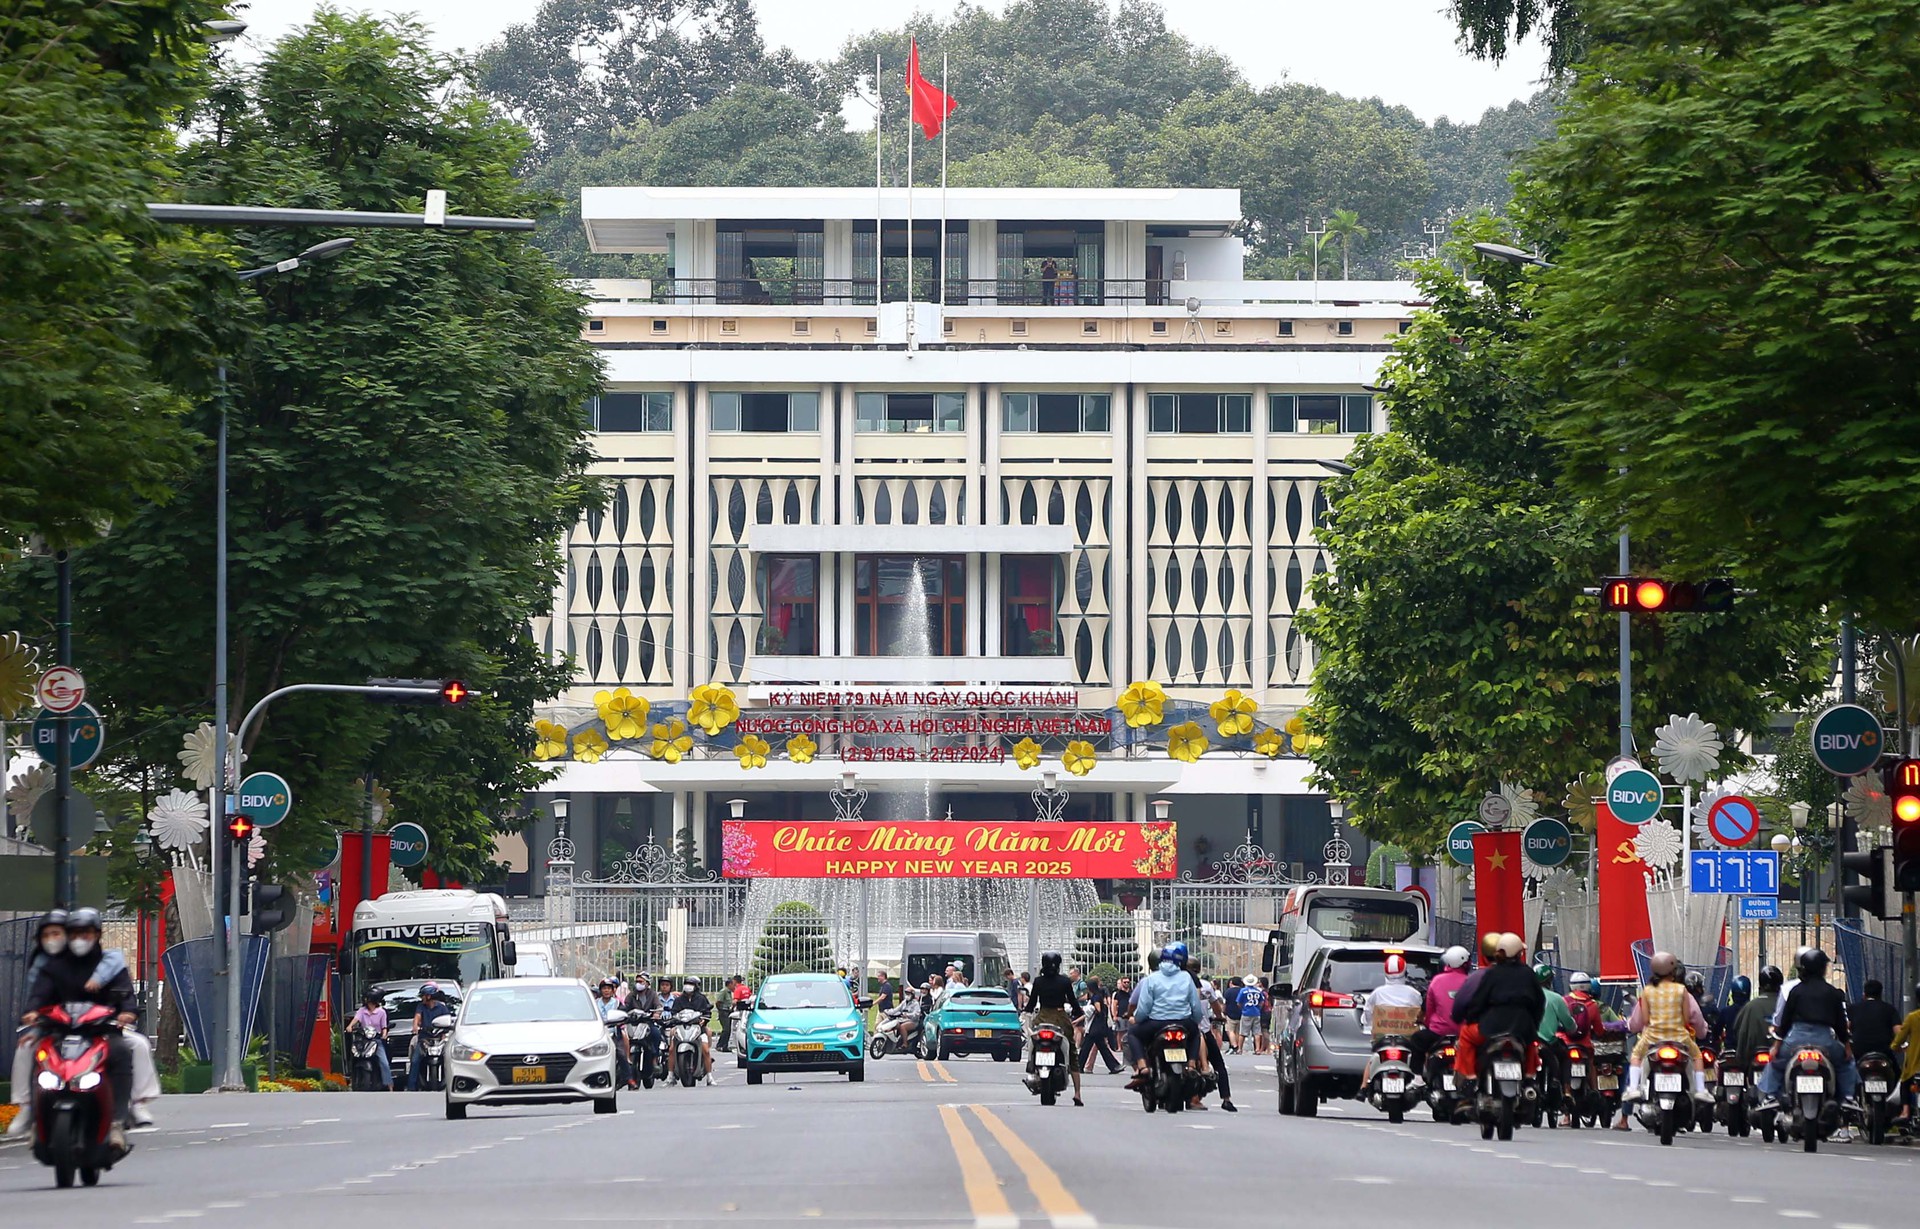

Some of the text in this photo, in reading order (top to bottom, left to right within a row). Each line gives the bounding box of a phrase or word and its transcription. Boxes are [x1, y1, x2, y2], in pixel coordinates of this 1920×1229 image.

[846, 691, 864, 706] 79
[869, 687, 908, 706] NĂM
[914, 687, 961, 706] NGÀY
[1020, 687, 1079, 706] KHÁNH
[843, 715, 879, 734] HÒA
[882, 715, 906, 734] XÃ
[981, 715, 1034, 733] NGHĨA
[1074, 718, 1112, 734] NAM
[39, 728, 81, 744] BIV
[1820, 734, 1862, 750] BIDV
[840, 746, 916, 765] (2/9/1945
[930, 745, 1006, 766] 2/9/2024)
[241, 794, 274, 807] BIDV
[1612, 789, 1646, 804] BIDV
[390, 839, 416, 852] BIDV
[772, 826, 1128, 857] Chúc Mừng Năm Mới
[1527, 838, 1557, 850] BIDV
[826, 860, 1073, 875] HAPPY NEW YEAR 2025
[1745, 909, 1773, 917] PASTEUR
[367, 923, 481, 941] UNIVERSE
[418, 934, 480, 945] New Premium
